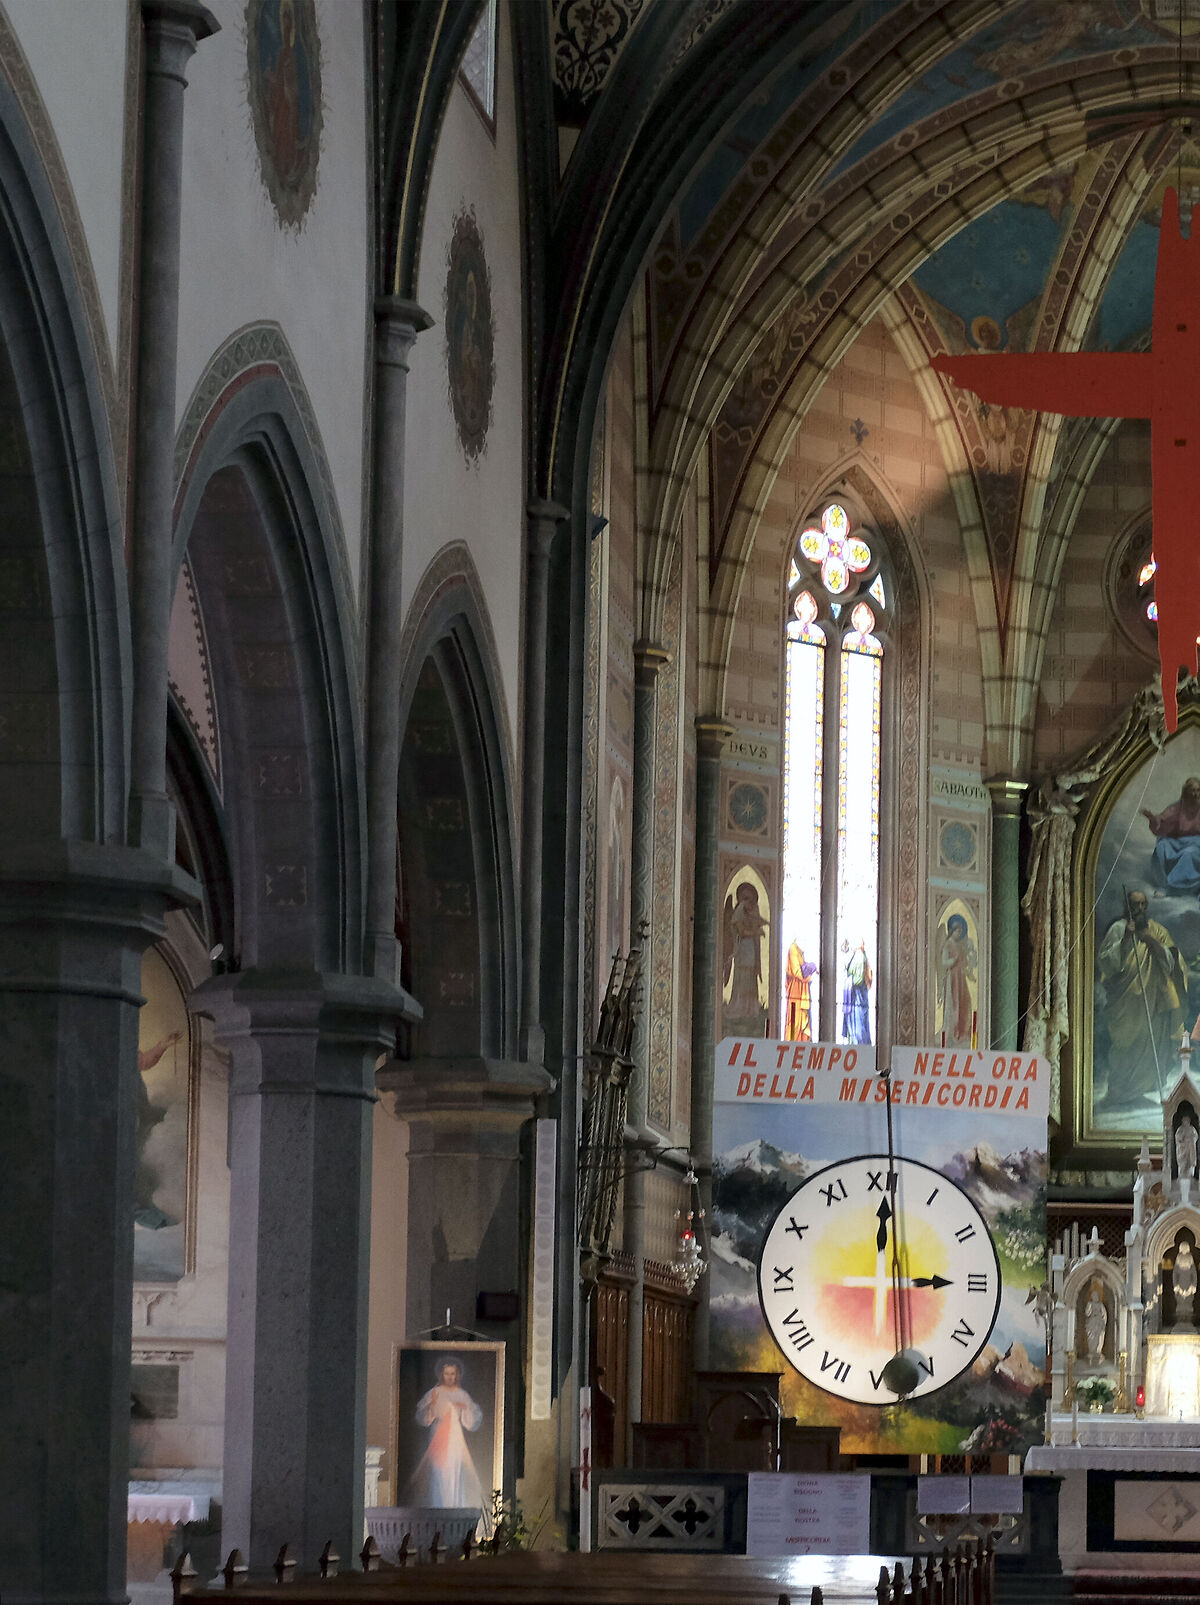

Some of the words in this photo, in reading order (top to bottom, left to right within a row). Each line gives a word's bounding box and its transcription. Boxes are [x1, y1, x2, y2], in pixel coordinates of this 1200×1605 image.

[728, 1042, 757, 1067] IL
[776, 1044, 858, 1072] TEMPO
[736, 1072, 815, 1099] DELLA
[839, 1077, 1030, 1110] MISERICORDIA
[819, 1179, 848, 1206] XI
[785, 1217, 808, 1239] X
[955, 1223, 976, 1243] II
[773, 1266, 794, 1293] IX
[967, 1273, 987, 1293] III
[782, 1308, 815, 1352] VIII
[951, 1318, 976, 1348] IV
[820, 1350, 851, 1383] VII
[918, 1356, 935, 1377] V
